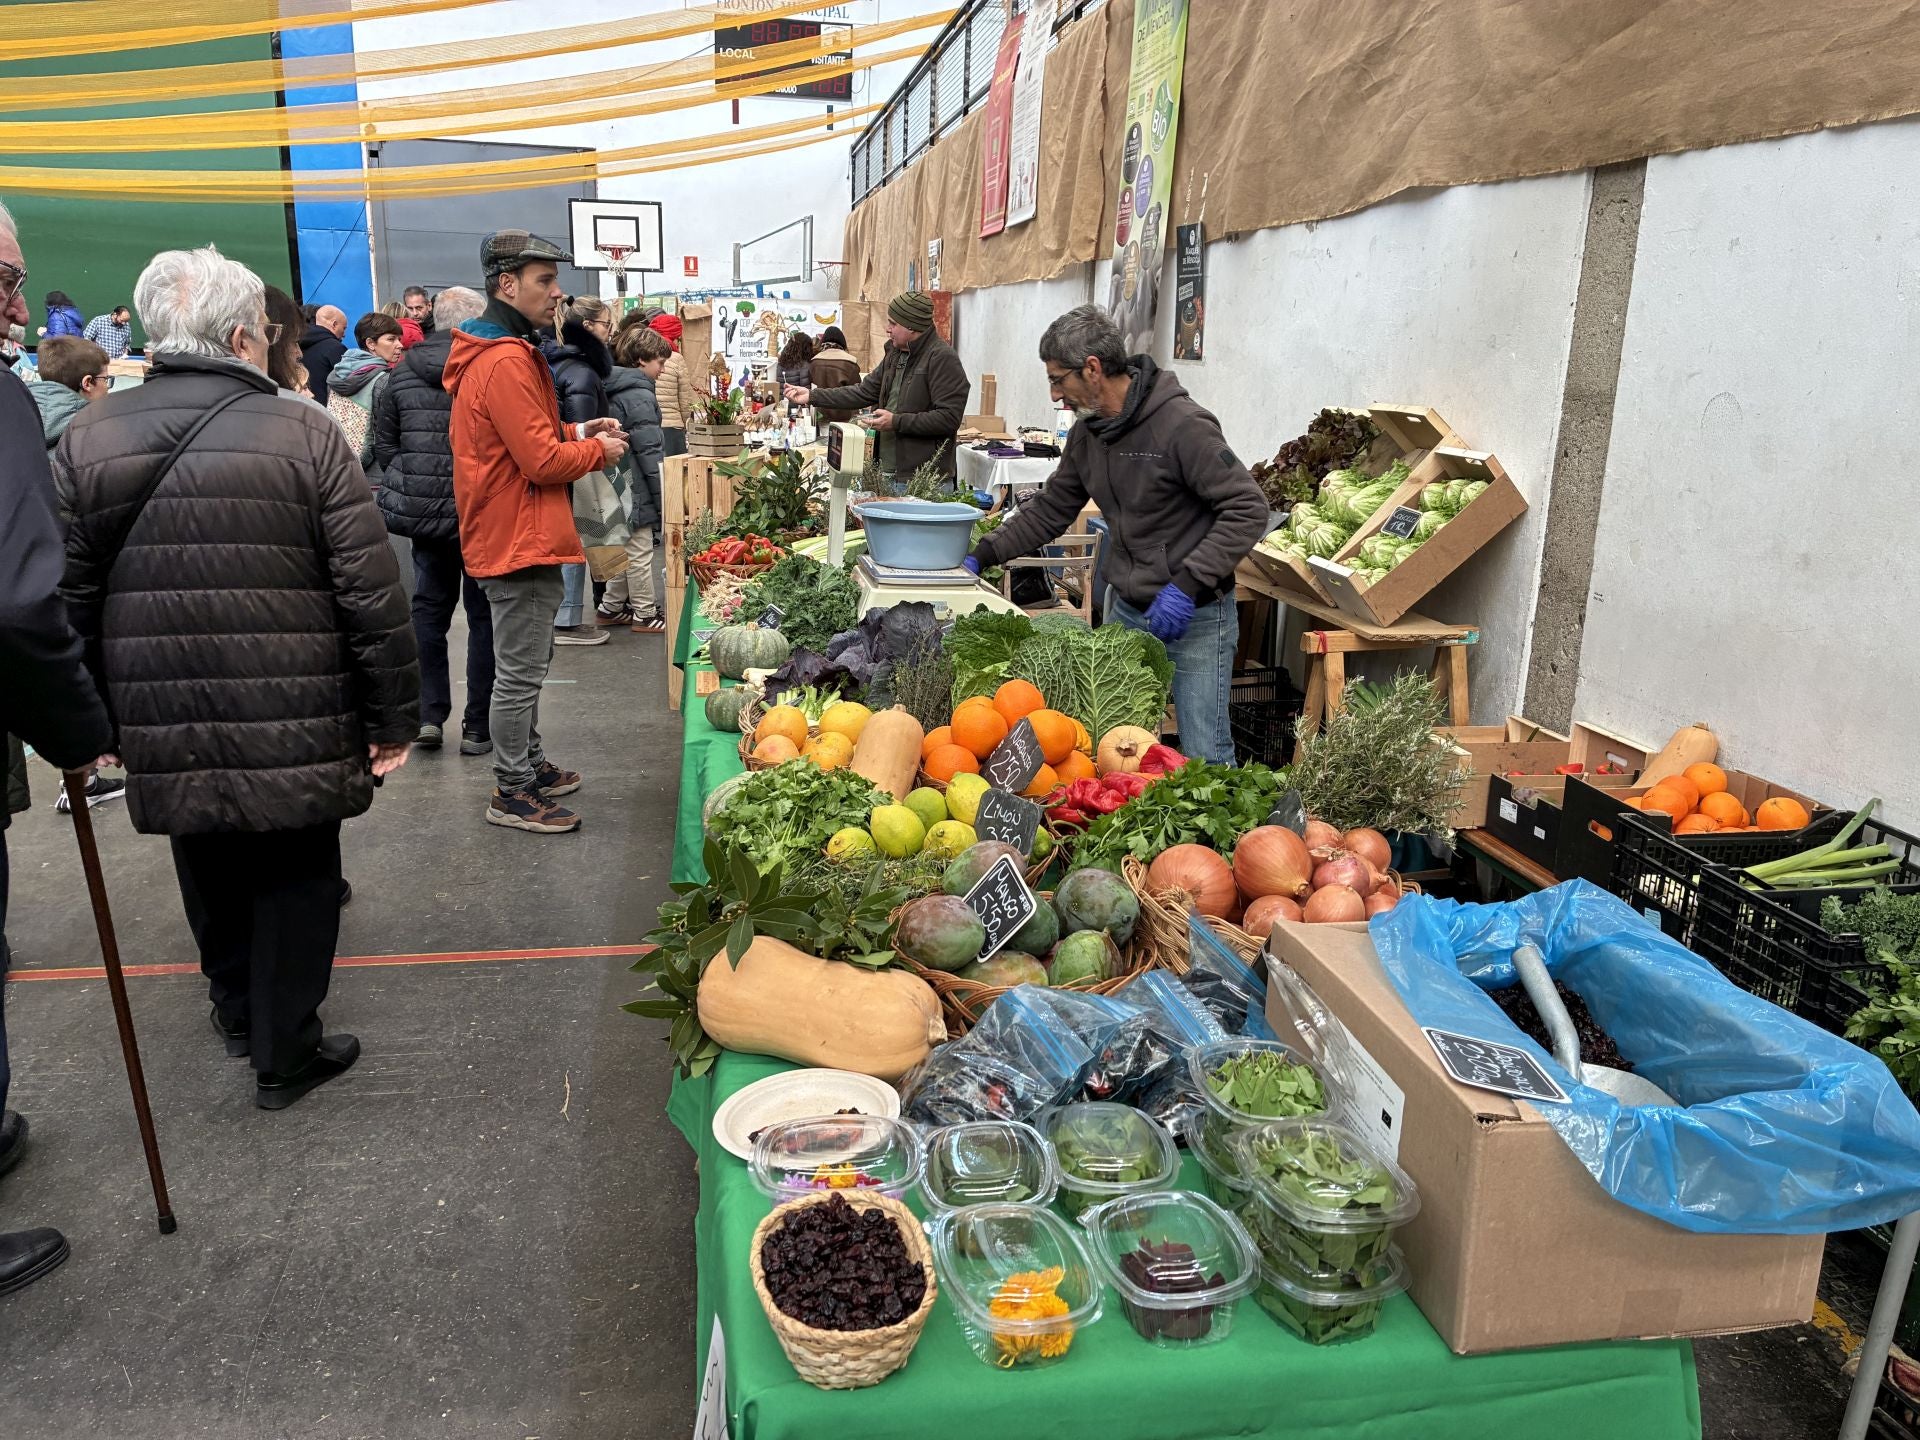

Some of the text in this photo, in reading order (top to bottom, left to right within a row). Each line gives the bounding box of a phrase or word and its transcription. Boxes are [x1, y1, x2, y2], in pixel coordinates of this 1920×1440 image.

[719, 47, 756, 60] LOCAL
[811, 55, 846, 66] VISITANTE
[1151, 109, 1167, 141] BIO
[989, 749, 1021, 788] 2'50
[988, 863, 1019, 919] MANGO
[973, 891, 1002, 933] 5'50
